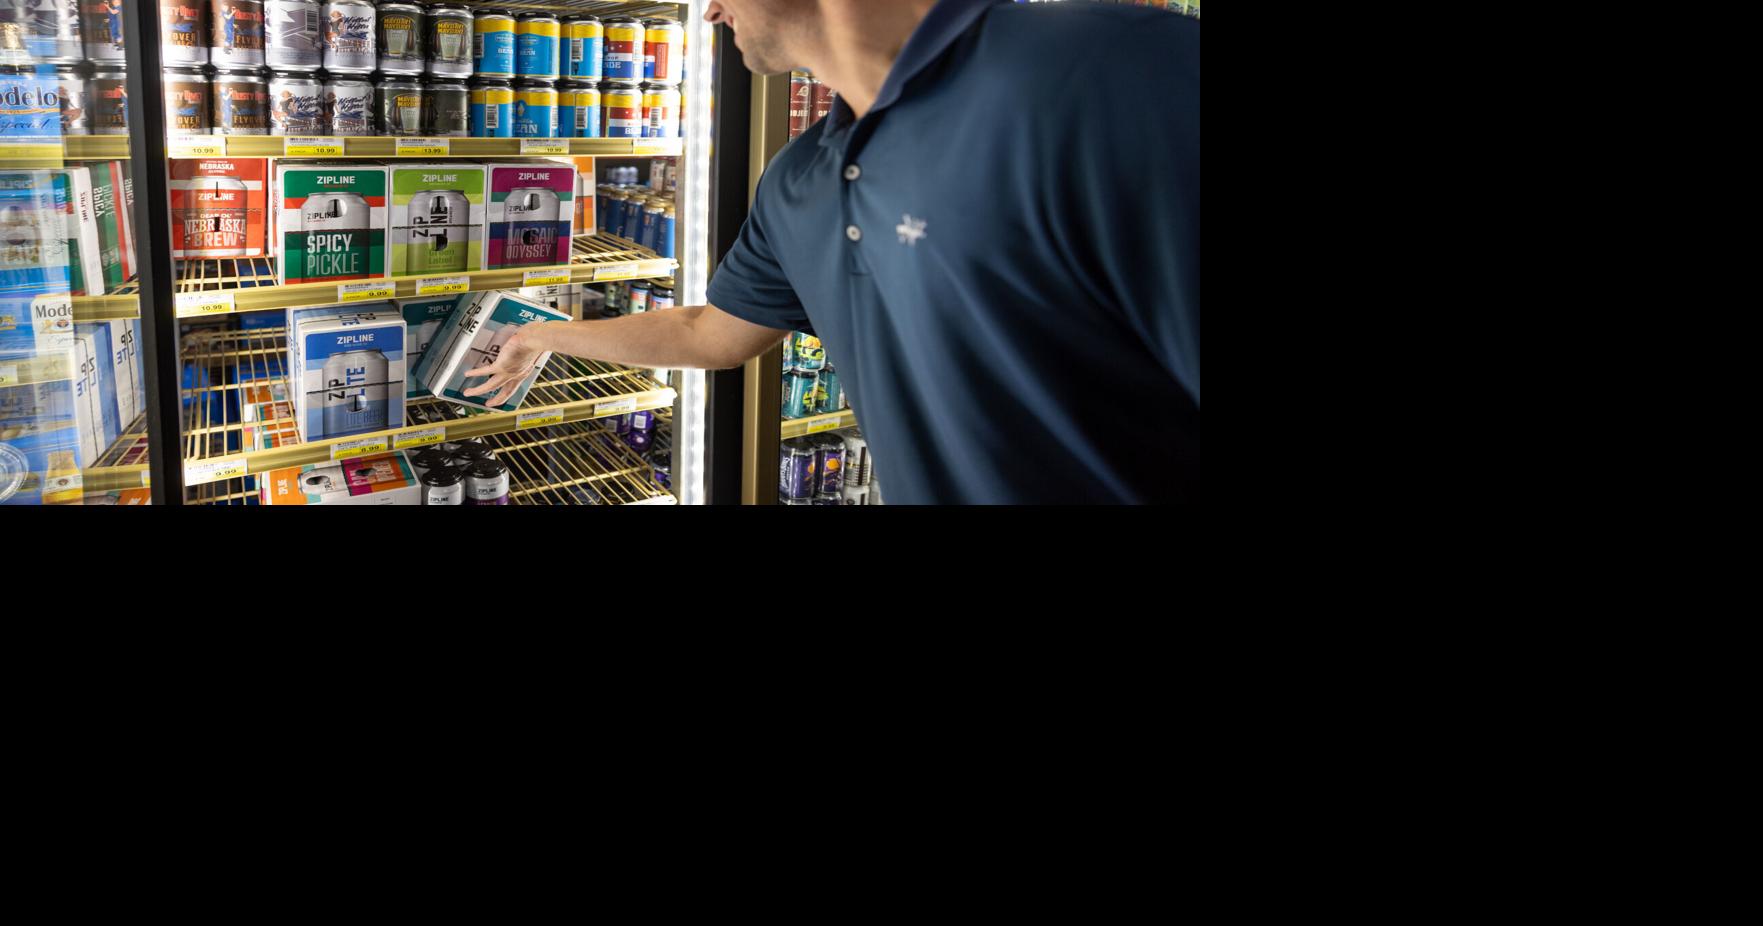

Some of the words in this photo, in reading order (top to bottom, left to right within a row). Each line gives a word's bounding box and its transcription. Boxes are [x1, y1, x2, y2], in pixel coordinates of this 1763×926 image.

[199, 163, 235, 171] NEBRASKA
[316, 175, 356, 185] ZIPLINE
[422, 174, 458, 183] ZIPLINE
[518, 172, 550, 181] ZIPLINE
[184, 218, 247, 235] NEBRASKA
[192, 231, 238, 248] BREW
[307, 233, 353, 254] SPICY
[505, 243, 552, 259] ODYSSEY
[307, 252, 359, 277] PICKLE
[518, 308, 548, 322] ZIPLINE
[336, 333, 375, 345] ZIPLINE
